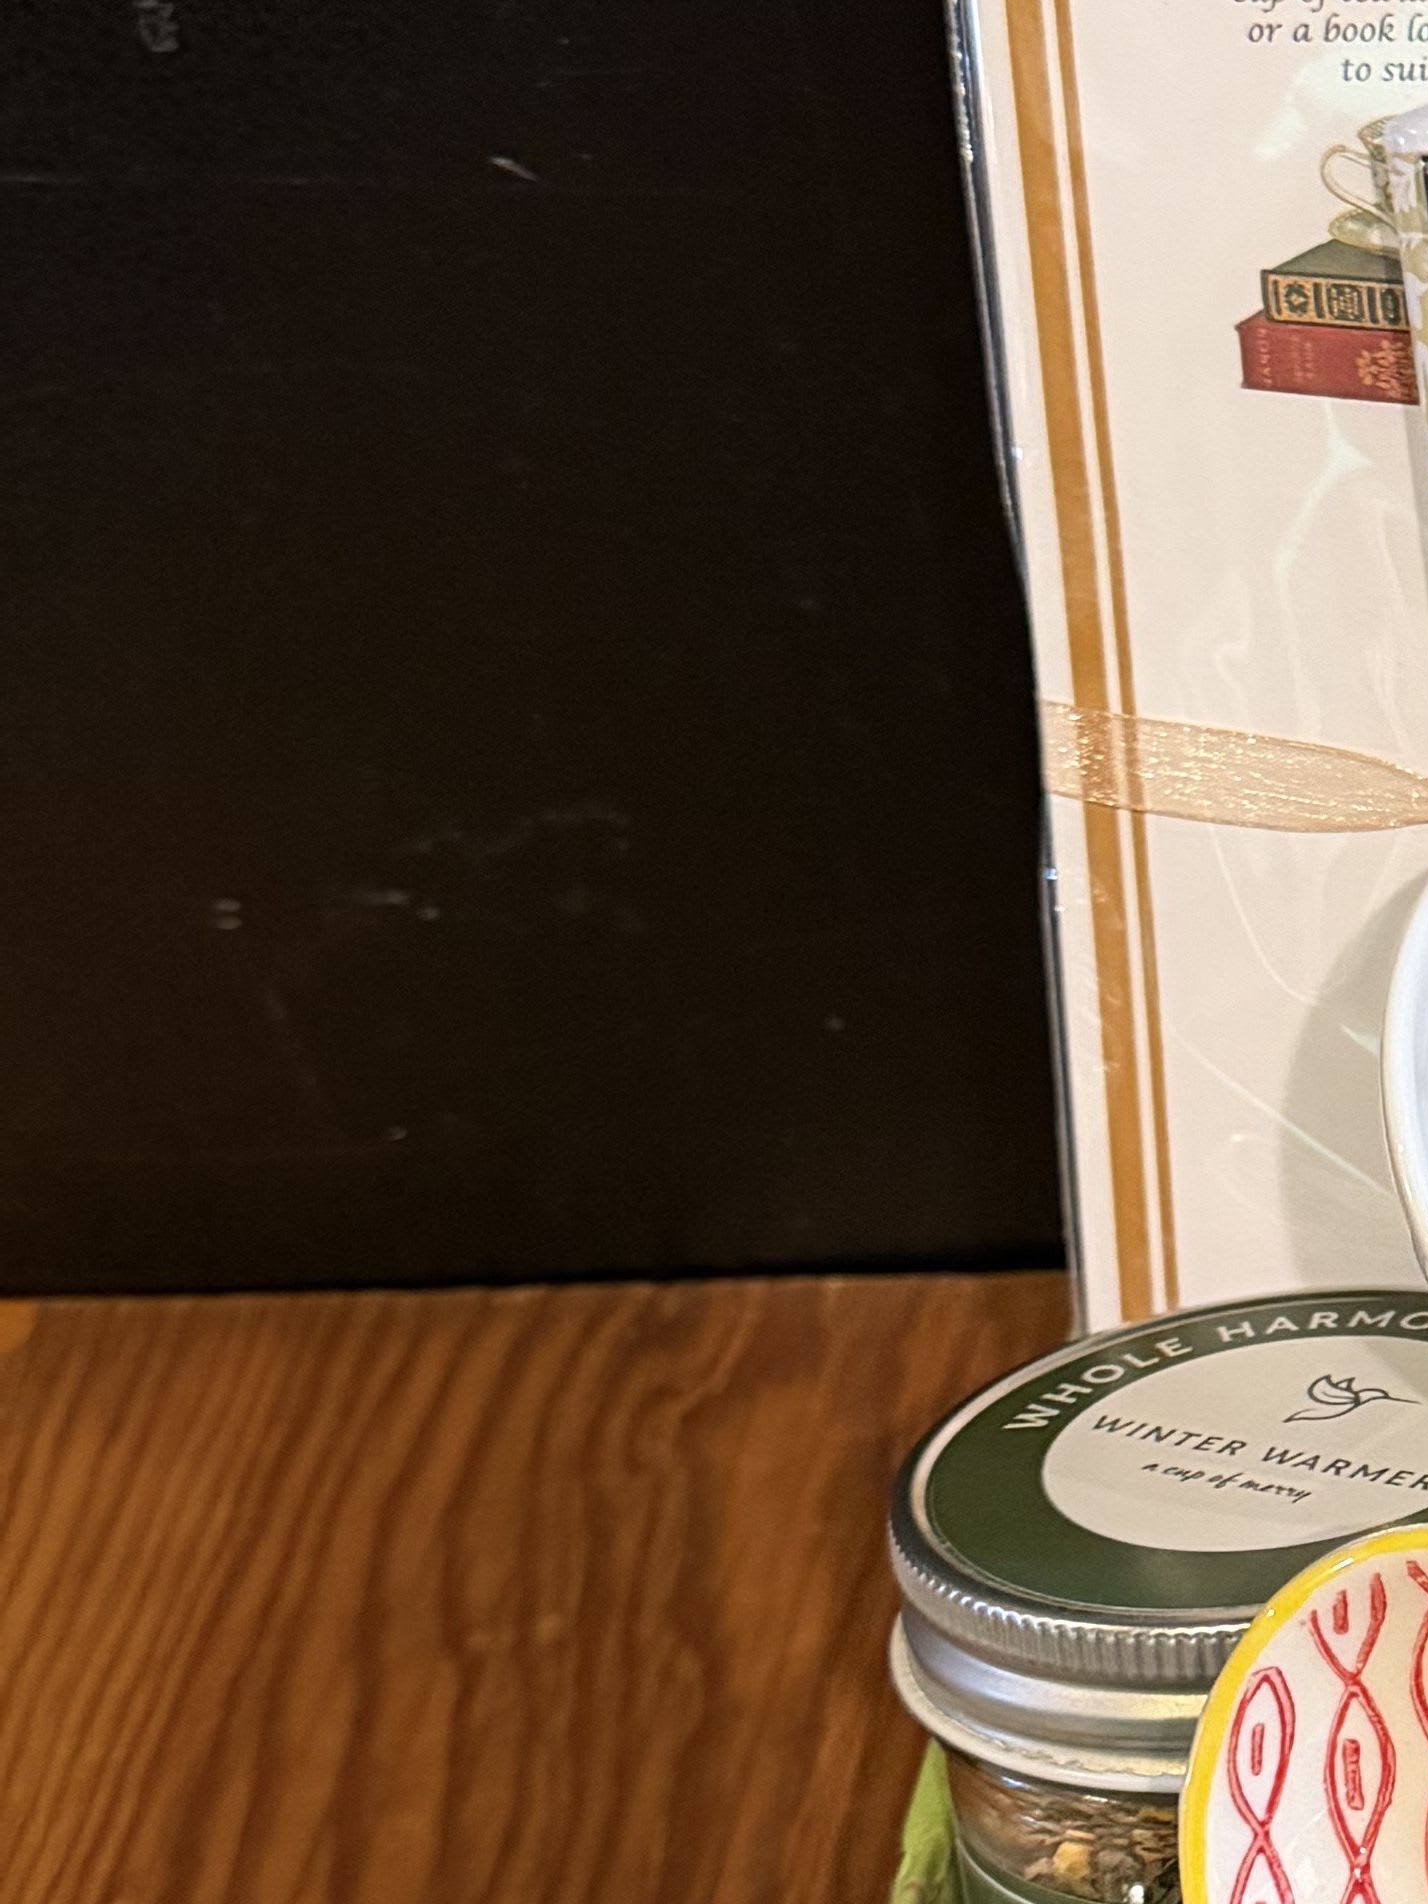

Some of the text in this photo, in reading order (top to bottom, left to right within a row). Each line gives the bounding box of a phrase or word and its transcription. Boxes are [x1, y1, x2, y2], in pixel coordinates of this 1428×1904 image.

[1247, 22, 1283, 44] or
[1292, 23, 1313, 44] a
[1323, 12, 1396, 44] book
[1342, 57, 1372, 82] to
[1002, 1336, 1188, 1434] WHOLE
[1093, 1414, 1242, 1457] WINTER
[1142, 1463, 1313, 1504] a cup of merry
